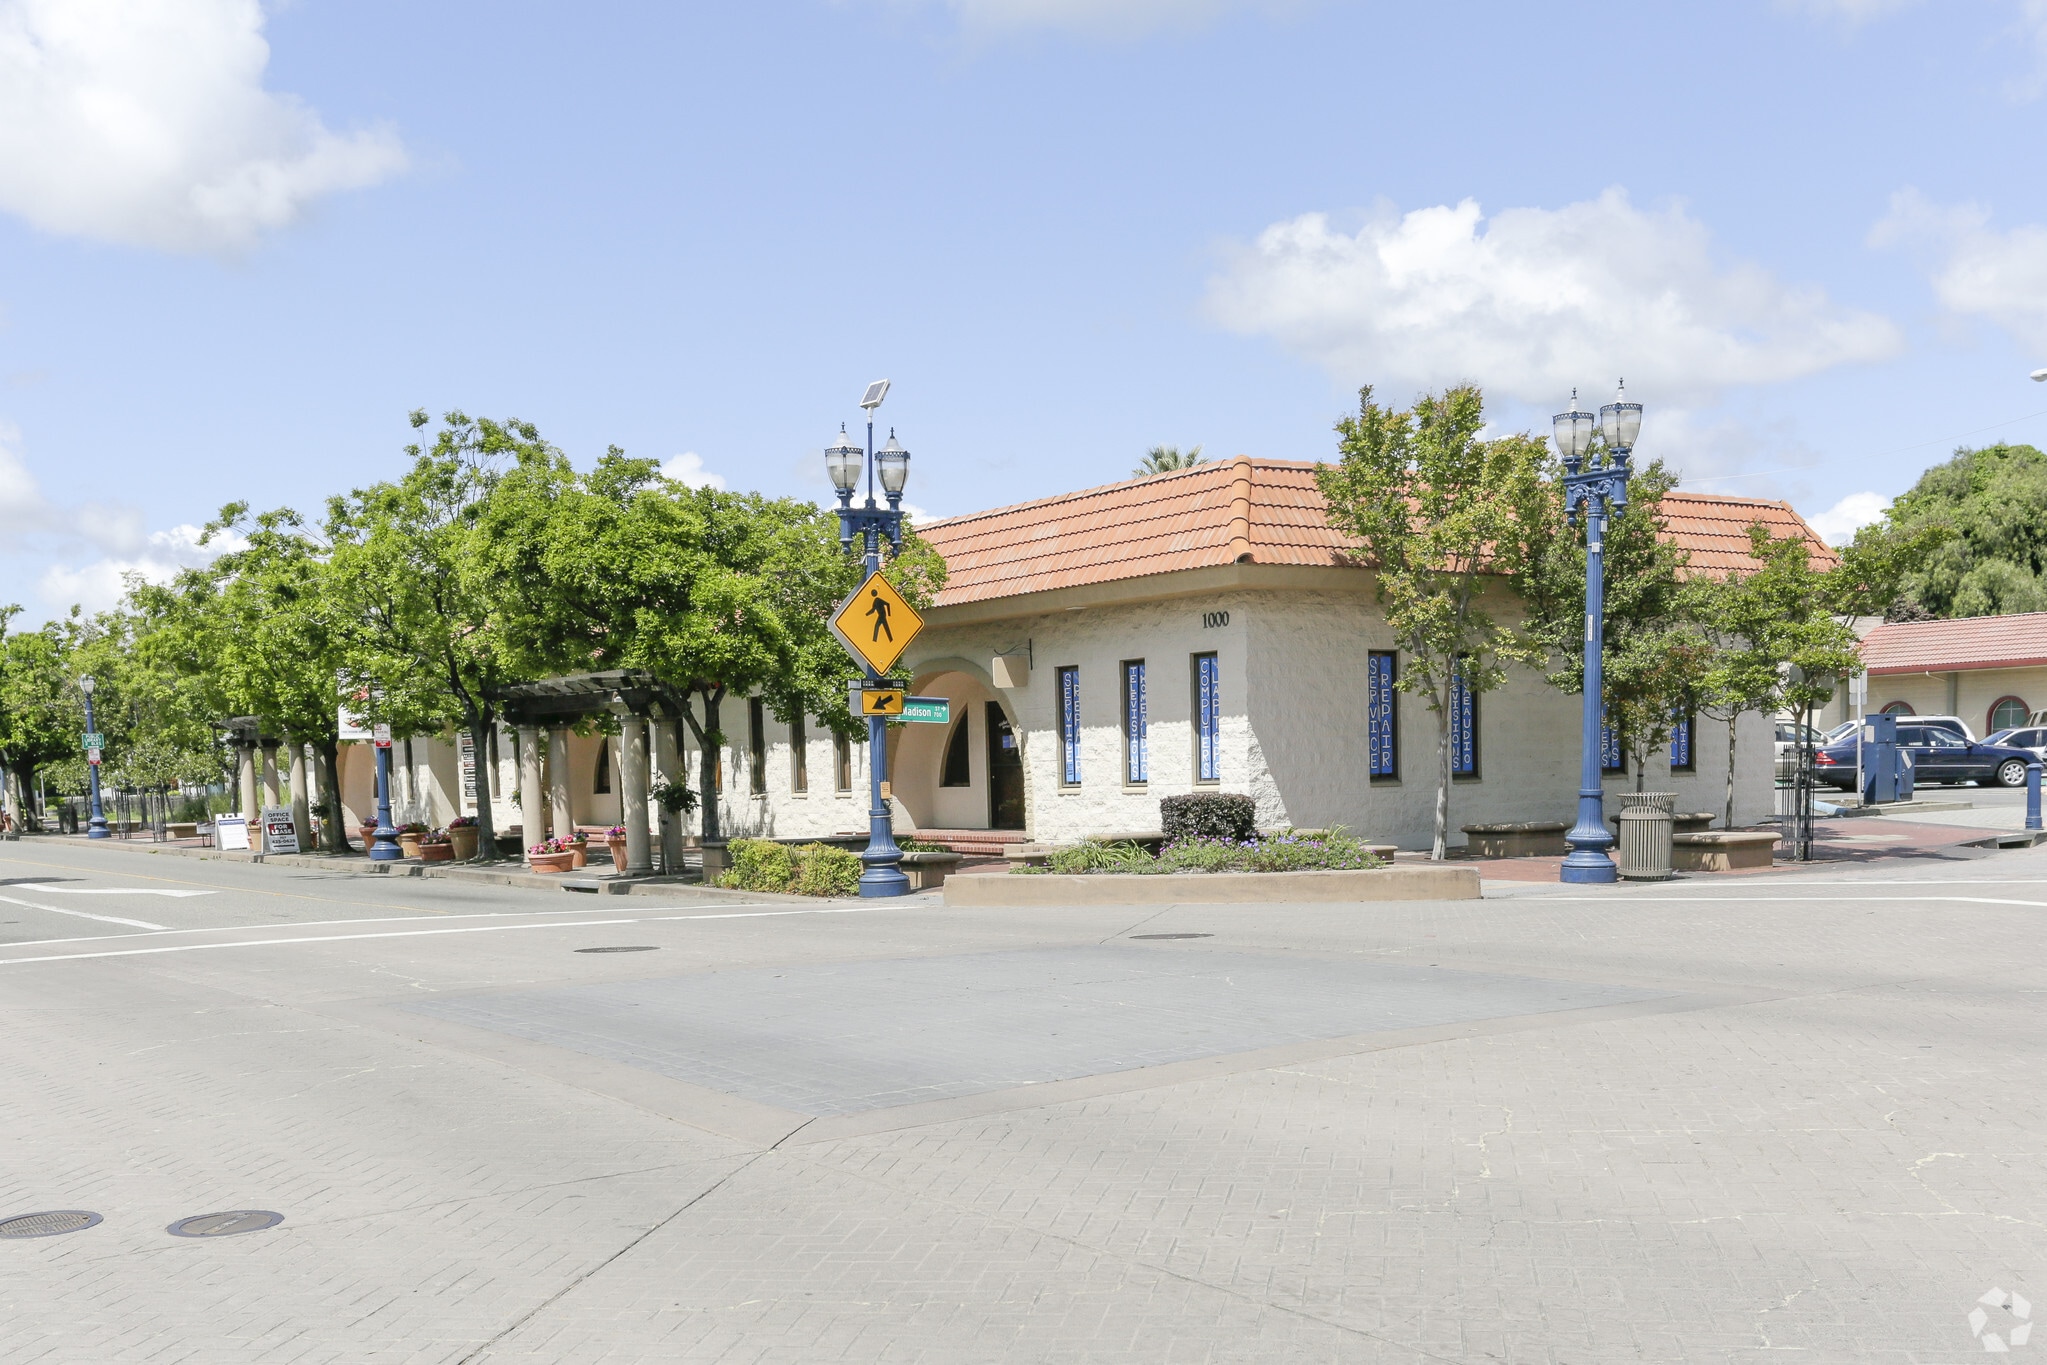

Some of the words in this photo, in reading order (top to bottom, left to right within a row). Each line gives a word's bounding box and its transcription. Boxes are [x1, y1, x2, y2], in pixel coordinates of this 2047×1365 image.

[1202, 611, 1230, 629] 1000
[1064, 673, 1073, 762] SERVICE
[1130, 667, 1139, 778] TELEVISIONS
[1200, 661, 1210, 777] COMPUTERS
[1212, 671, 1220, 775] LAPTOPS
[1369, 658, 1378, 769] SERVICE
[1381, 673, 1391, 767] REPAIR
